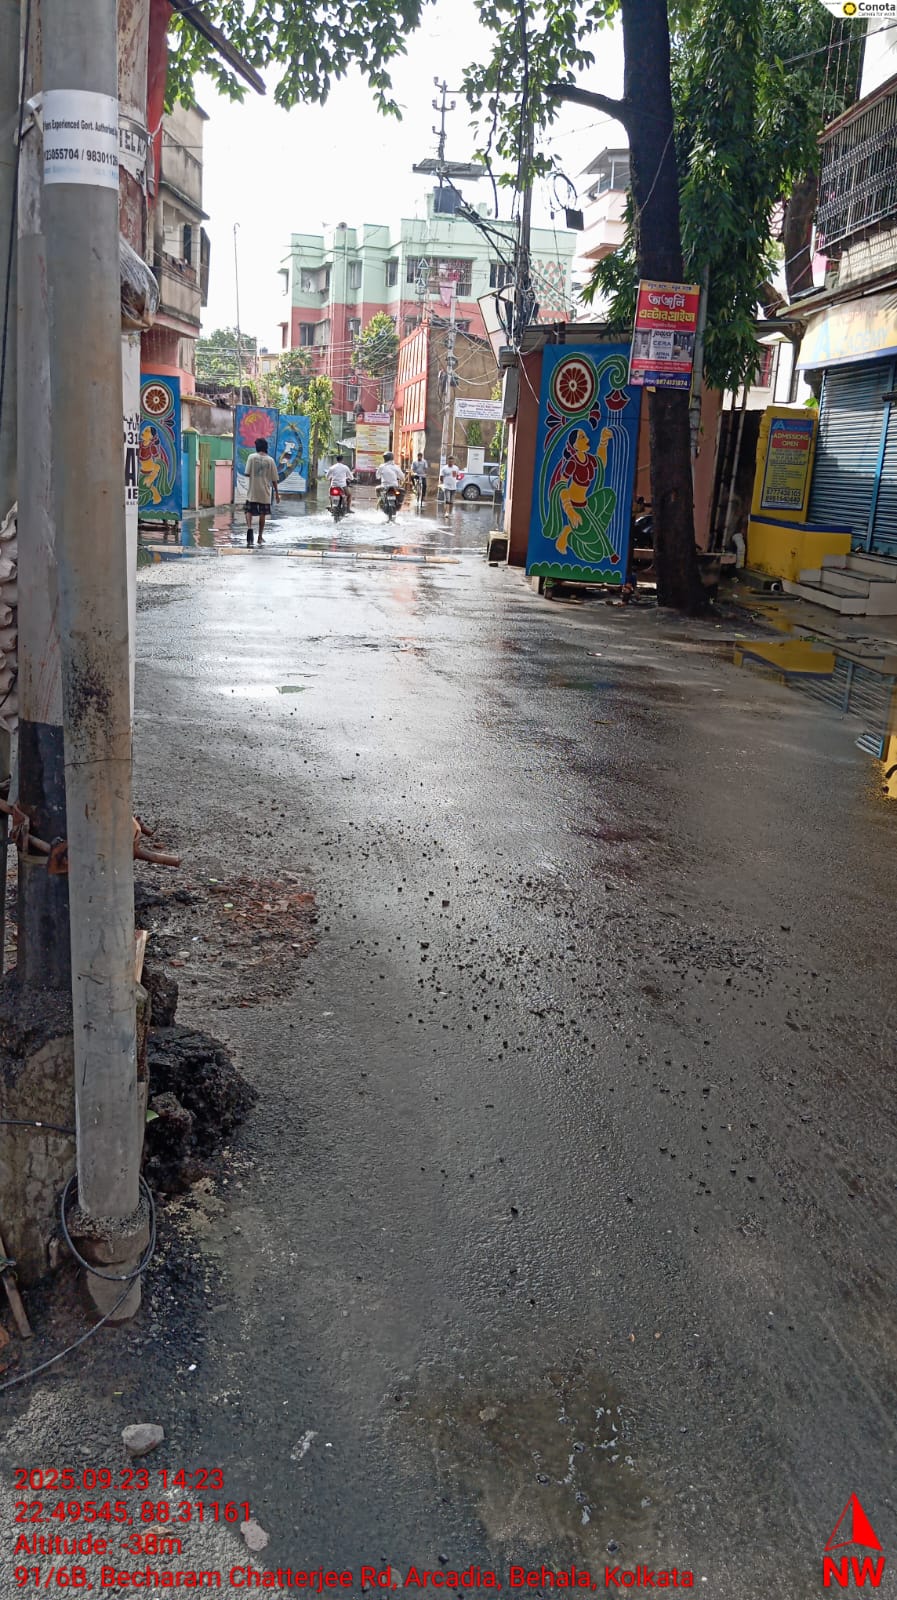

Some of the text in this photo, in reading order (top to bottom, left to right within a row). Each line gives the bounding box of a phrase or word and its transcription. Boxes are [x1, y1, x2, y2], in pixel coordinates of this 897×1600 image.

[52, 120, 80, 131] Experienced
[81, 120, 94, 130] Govt.
[773, 432, 809, 440] ADMISSIONS
